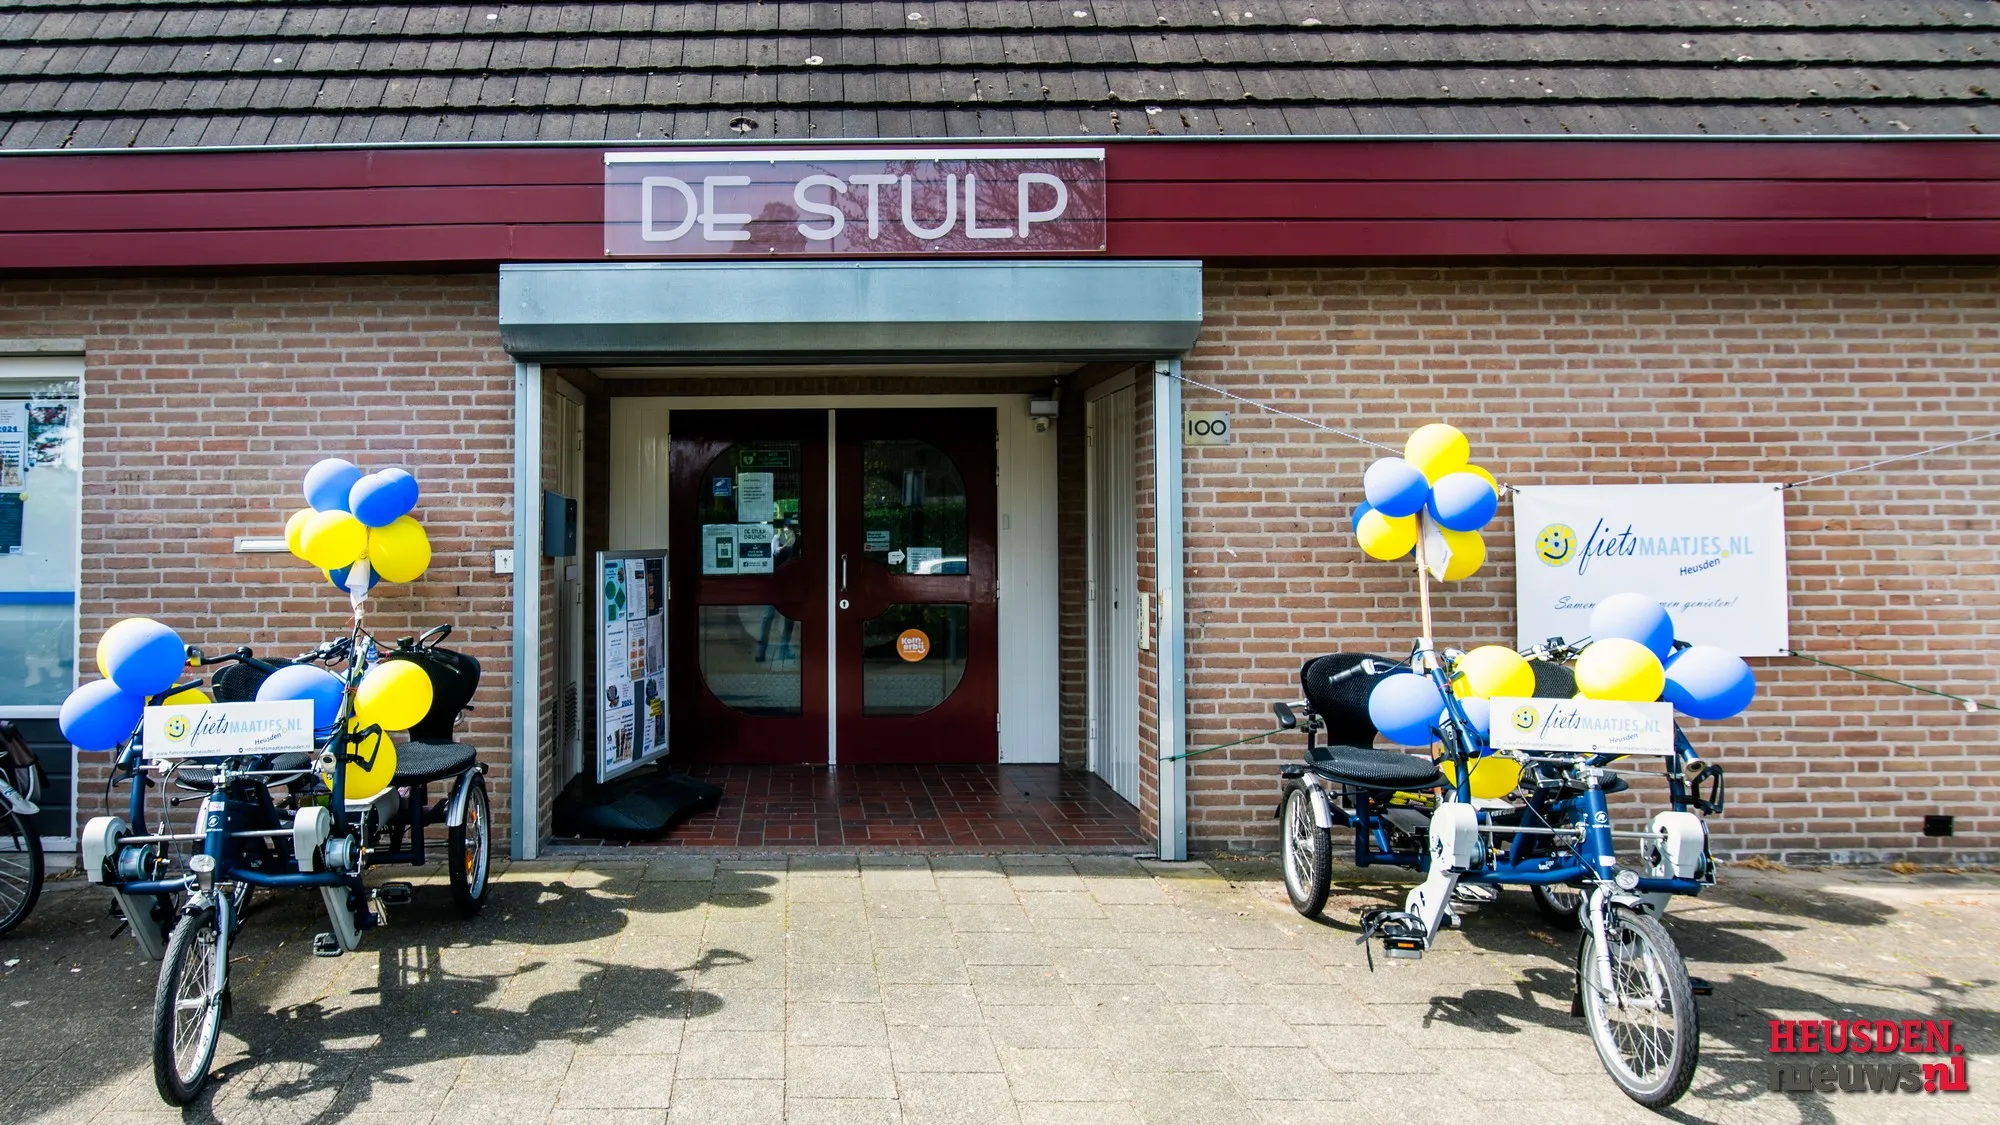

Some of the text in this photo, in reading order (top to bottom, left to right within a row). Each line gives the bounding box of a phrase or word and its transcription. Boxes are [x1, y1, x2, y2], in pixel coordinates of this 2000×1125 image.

[642, 173, 1068, 242] DE STULP
[1188, 419, 1227, 436] 100
[1679, 557, 1721, 577] Heusden
[1554, 595, 1596, 610] Samen
[1680, 596, 1739, 613] genieten!
[901, 637, 921, 645] Kom
[254, 732, 282, 746] Heusden
[1609, 733, 1639, 744] Heusden
